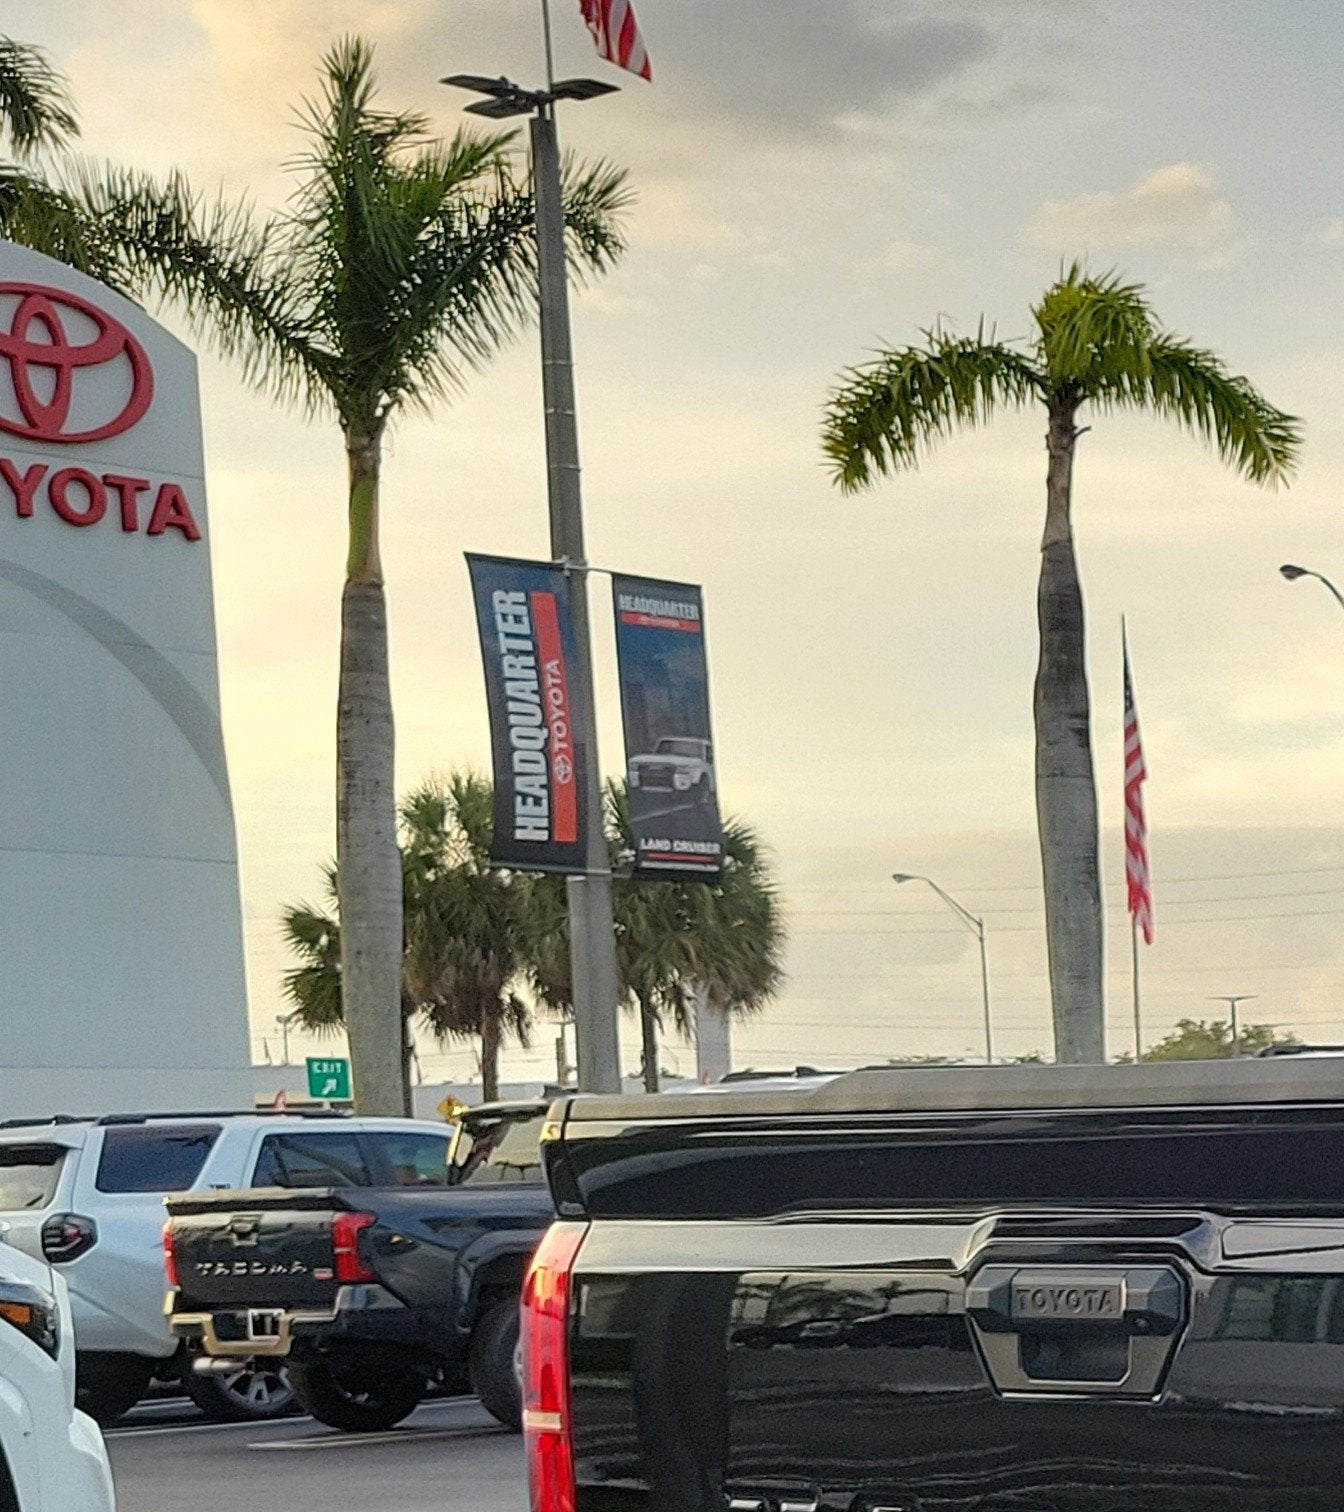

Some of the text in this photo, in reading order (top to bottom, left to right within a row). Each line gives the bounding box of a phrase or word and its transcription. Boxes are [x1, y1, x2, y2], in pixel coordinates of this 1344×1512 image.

[492, 589, 549, 842] HEADQUARTER
[545, 658, 569, 752] TOYOTA
[640, 838, 671, 851] LAND
[312, 1061, 342, 1073] EXIT
[1015, 1288, 1114, 1313] TOYOTA
